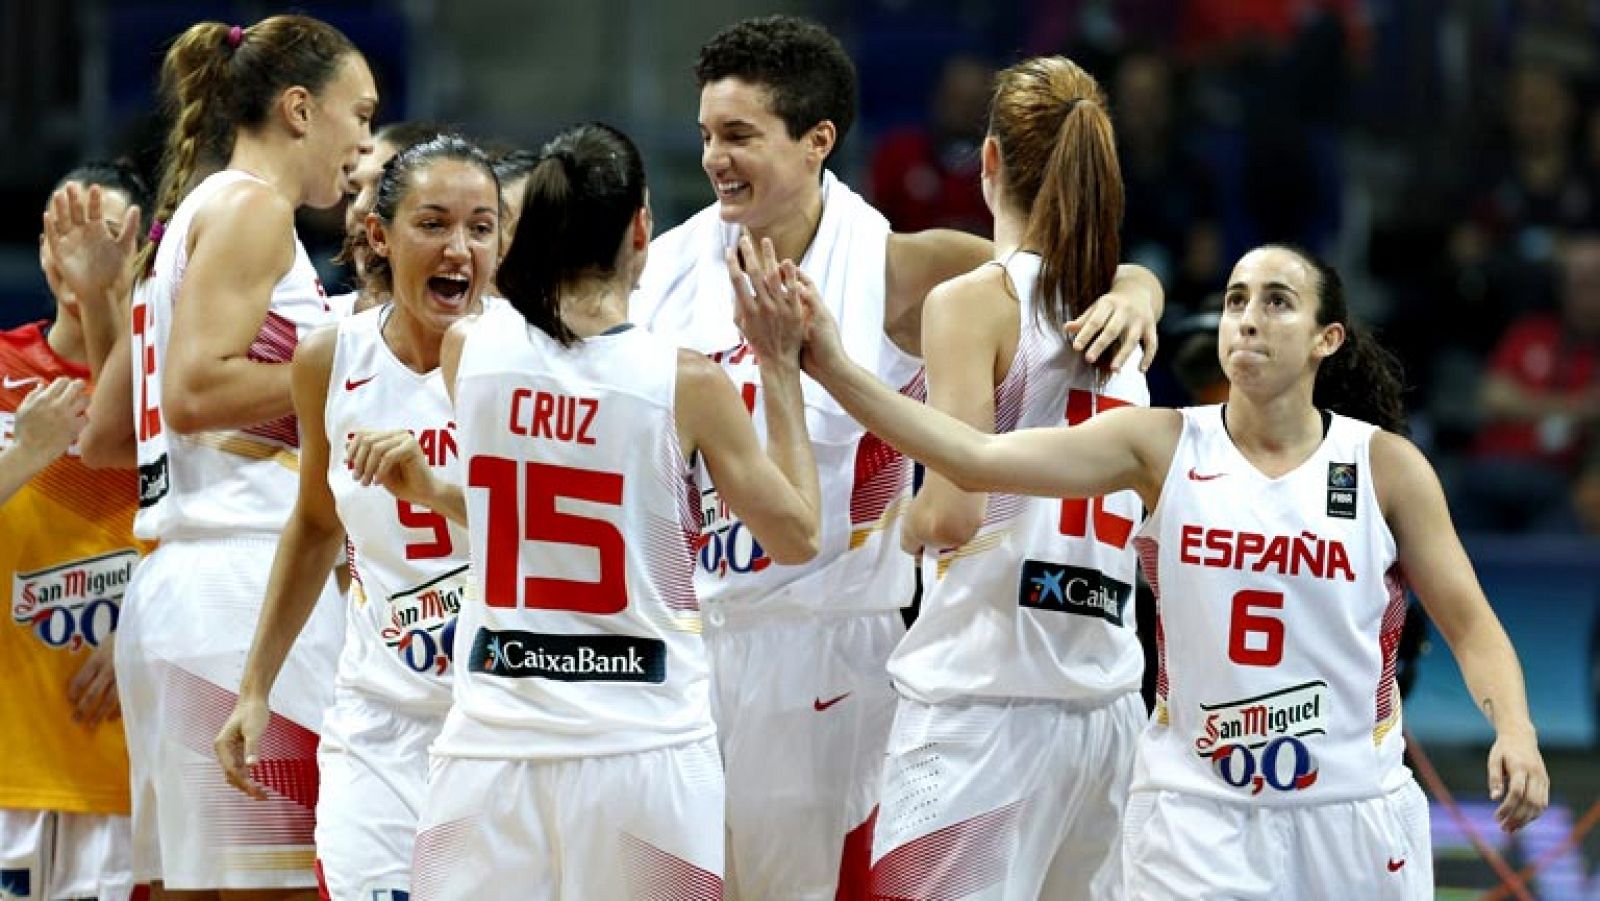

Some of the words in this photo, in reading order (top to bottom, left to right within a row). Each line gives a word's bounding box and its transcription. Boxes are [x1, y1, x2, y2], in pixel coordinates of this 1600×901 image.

[509, 387, 600, 446] CRUZ
[468, 454, 629, 616] 15
[1180, 525, 1356, 583] ESPAÑA
[502, 639, 646, 675] CaixaBank
[1228, 590, 1285, 668] 6
